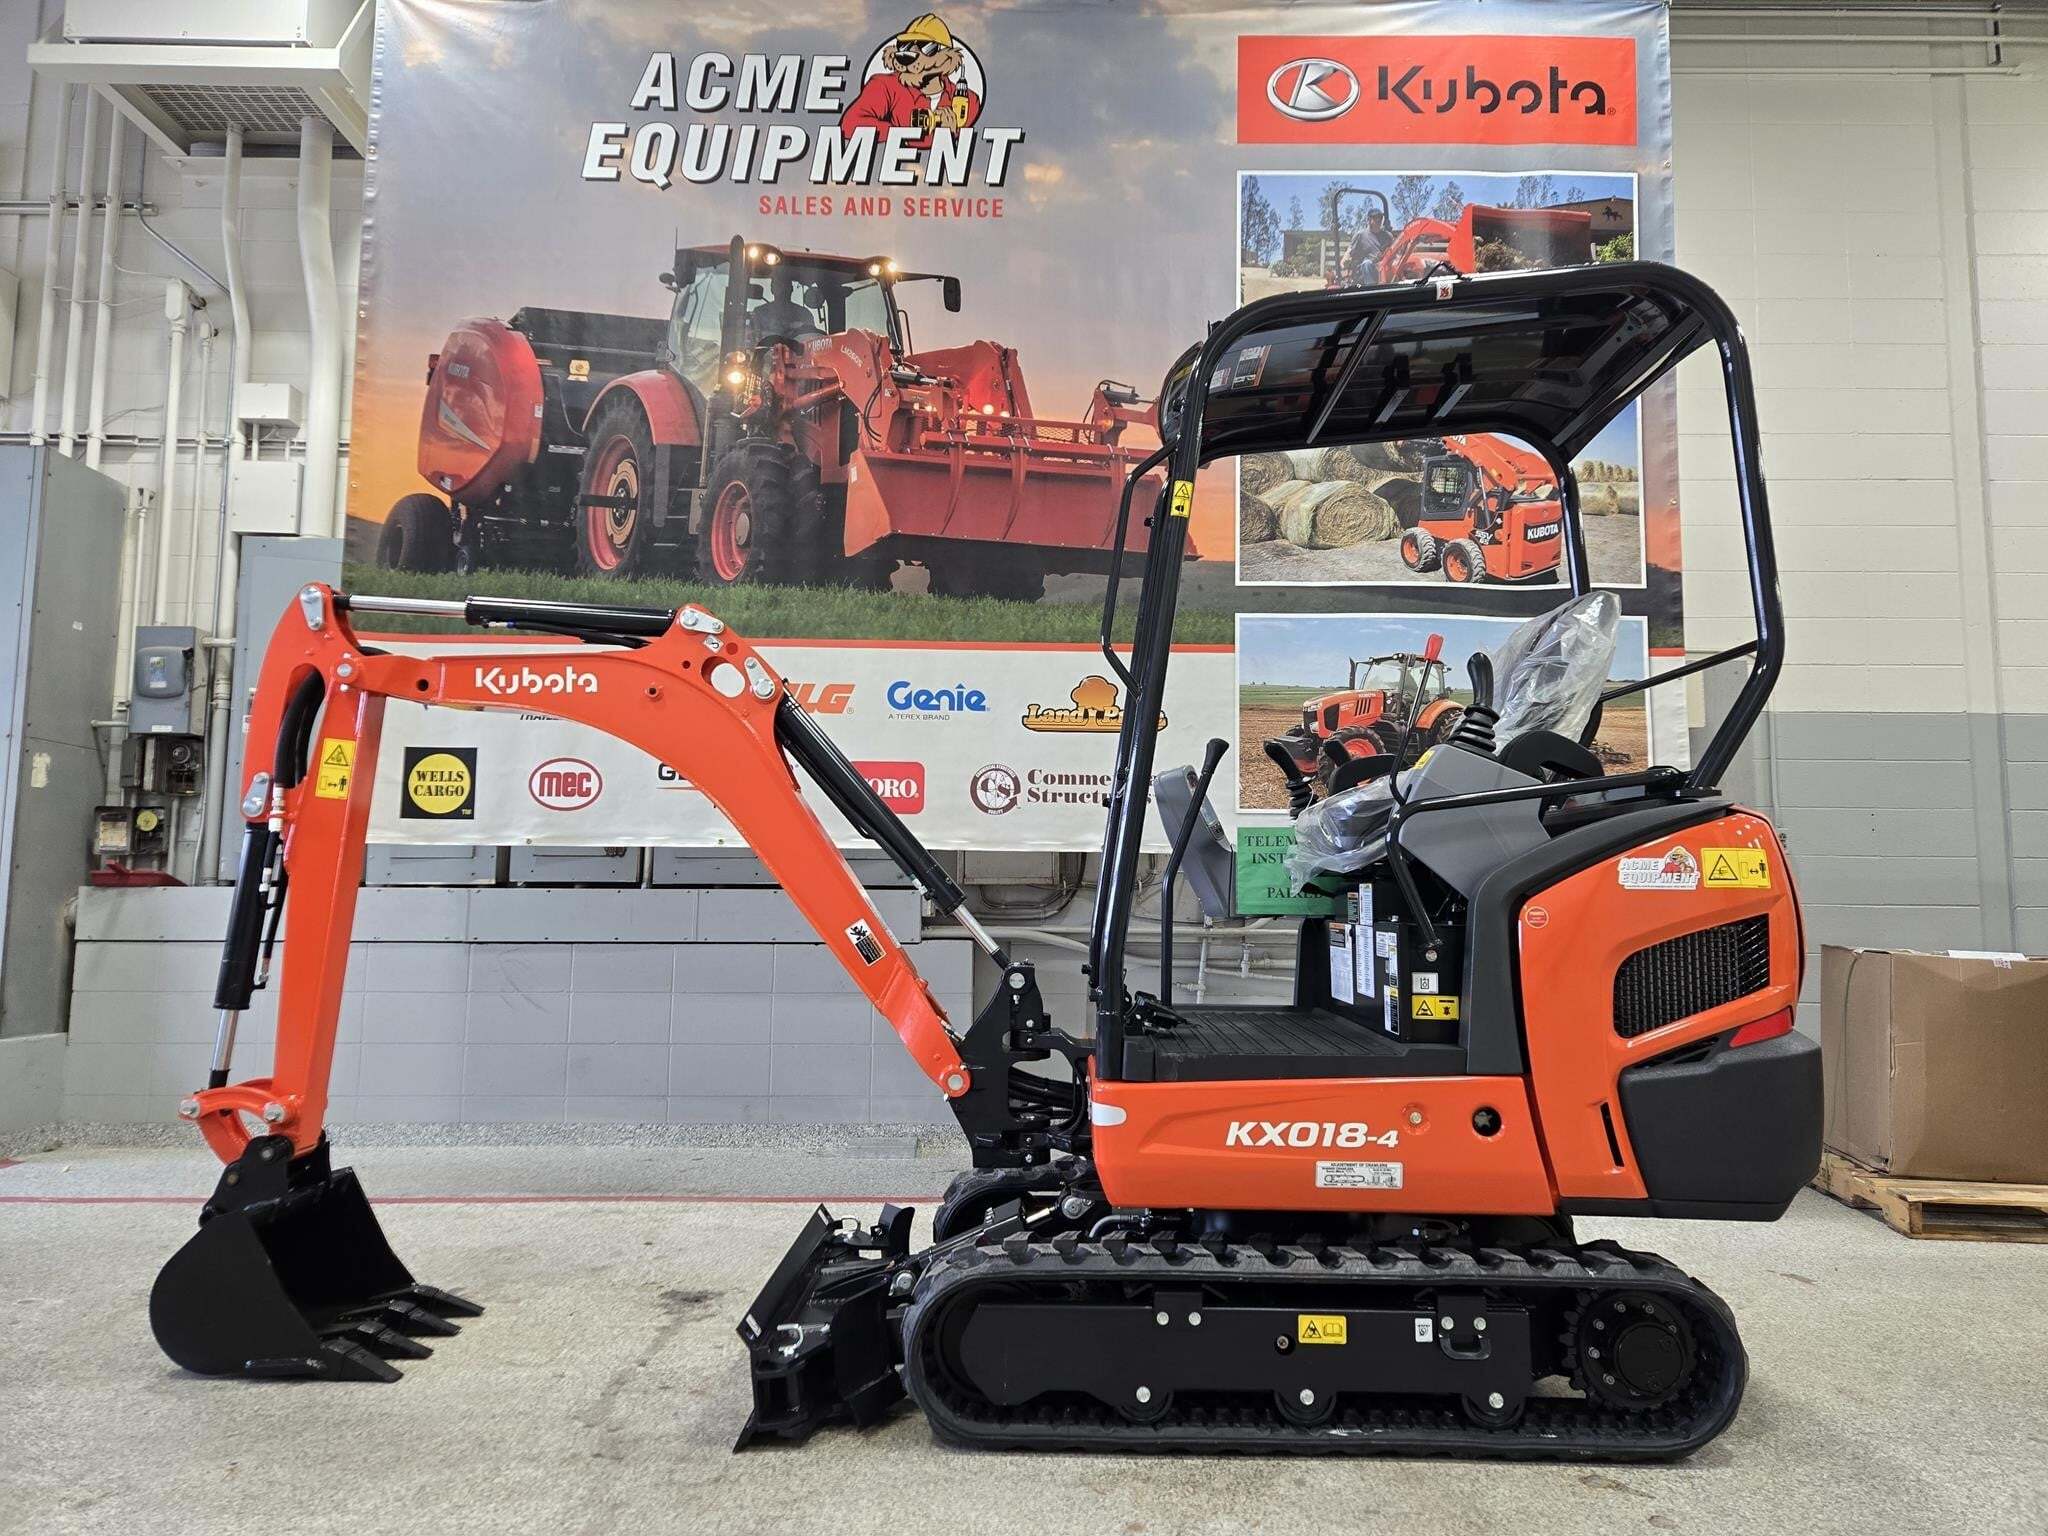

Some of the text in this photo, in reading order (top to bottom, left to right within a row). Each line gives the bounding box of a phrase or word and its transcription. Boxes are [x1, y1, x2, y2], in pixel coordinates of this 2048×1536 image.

[629, 51, 851, 113] ACME
[1377, 64, 1606, 115] Kubota
[580, 121, 1026, 190] EQUIPMENT
[759, 194, 1004, 219] SALES AND SERVICE
[1527, 523, 1559, 540] KUBOTA
[475, 666, 598, 695] Kubota
[887, 680, 986, 712] Genie
[1026, 703, 1085, 724] Land
[416, 770, 465, 783] WELLS
[413, 784, 465, 797] CARGO
[1620, 859, 1660, 871] ACME
[1620, 872, 1699, 884] EQUIPMENT
[1225, 1121, 1399, 1148] KX018-4
